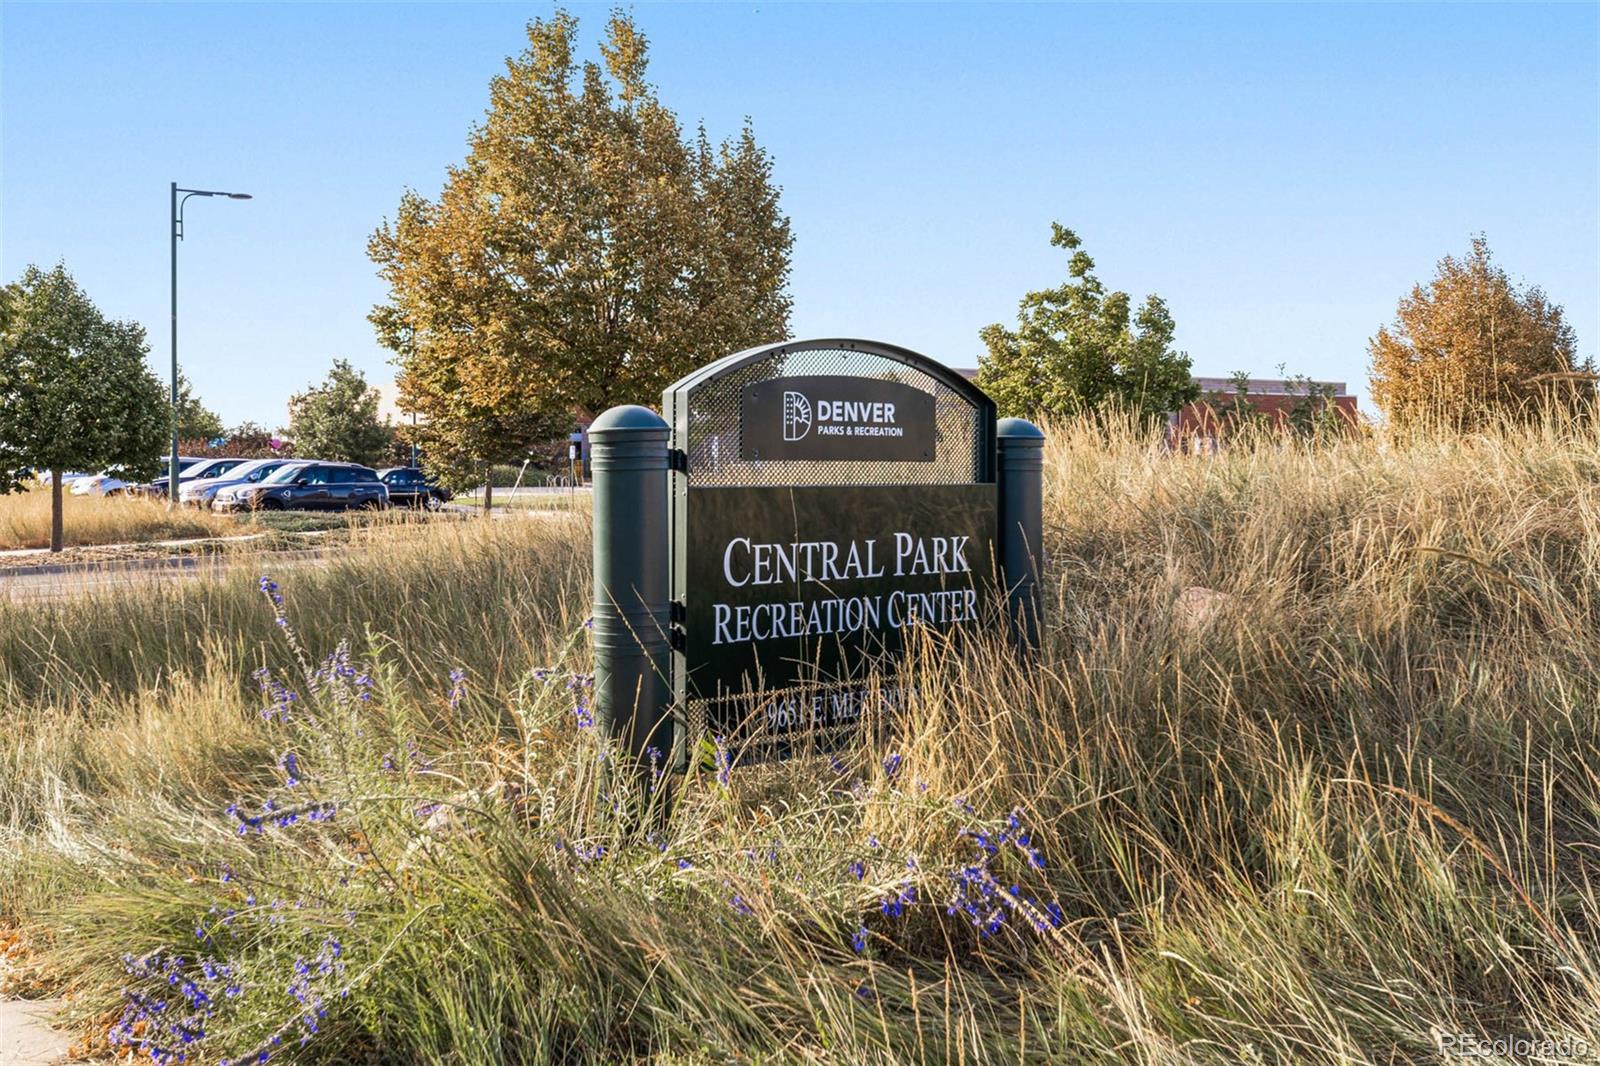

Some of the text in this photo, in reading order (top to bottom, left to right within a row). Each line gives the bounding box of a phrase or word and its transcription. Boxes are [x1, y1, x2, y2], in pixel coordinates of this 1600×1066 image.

[817, 400, 895, 423] DENVER
[818, 426, 903, 437] PARKS & RECREATION
[723, 532, 972, 587] CENTRAL PARK
[712, 589, 977, 645] RECREATION CENTER
